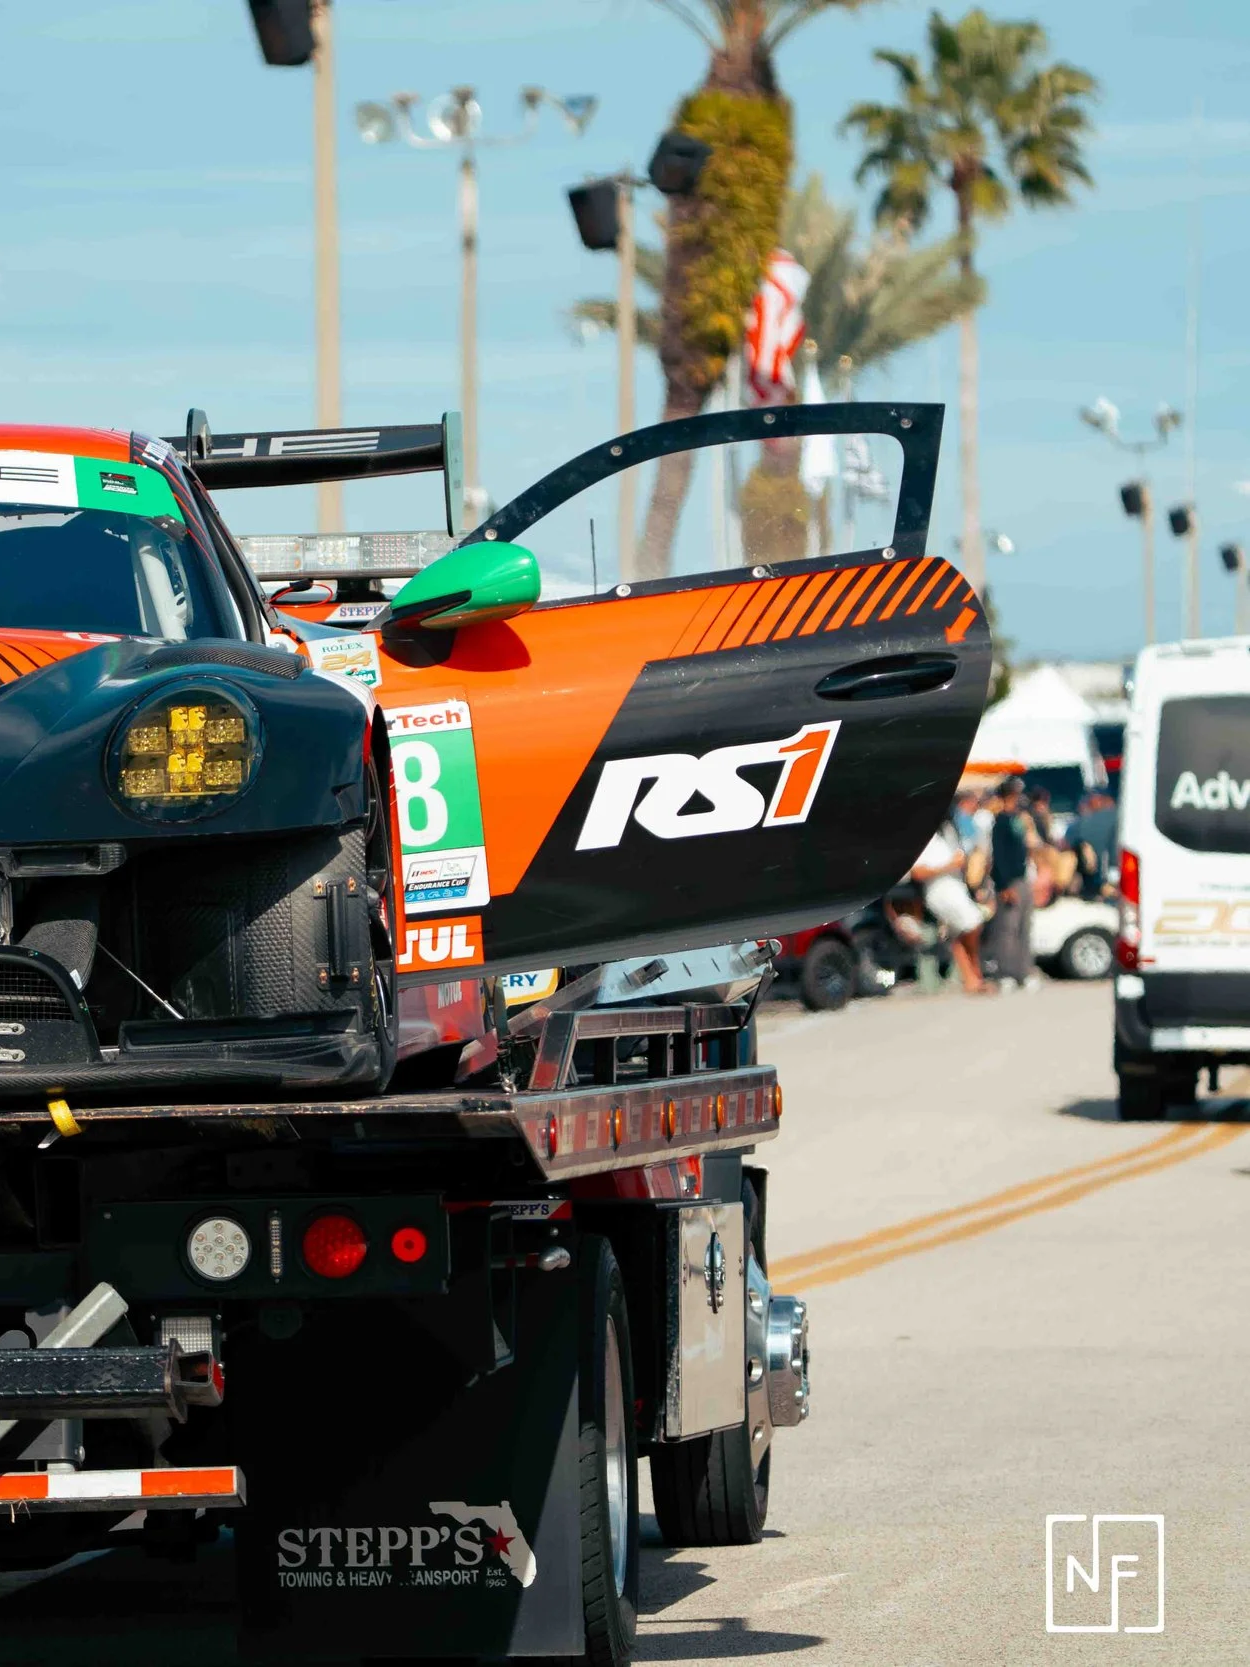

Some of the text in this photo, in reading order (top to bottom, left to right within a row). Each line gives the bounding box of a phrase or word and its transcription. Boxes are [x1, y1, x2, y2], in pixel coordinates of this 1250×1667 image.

[322, 642, 364, 653] ROLEX
[321, 650, 372, 671] 24
[391, 740, 449, 847] 8
[575, 719, 842, 851] RS1
[277, 1526, 485, 1568] STEPP'S
[278, 1570, 479, 1587] TOWING & HEAVY ANSPORT
[487, 1568, 505, 1577] Est.
